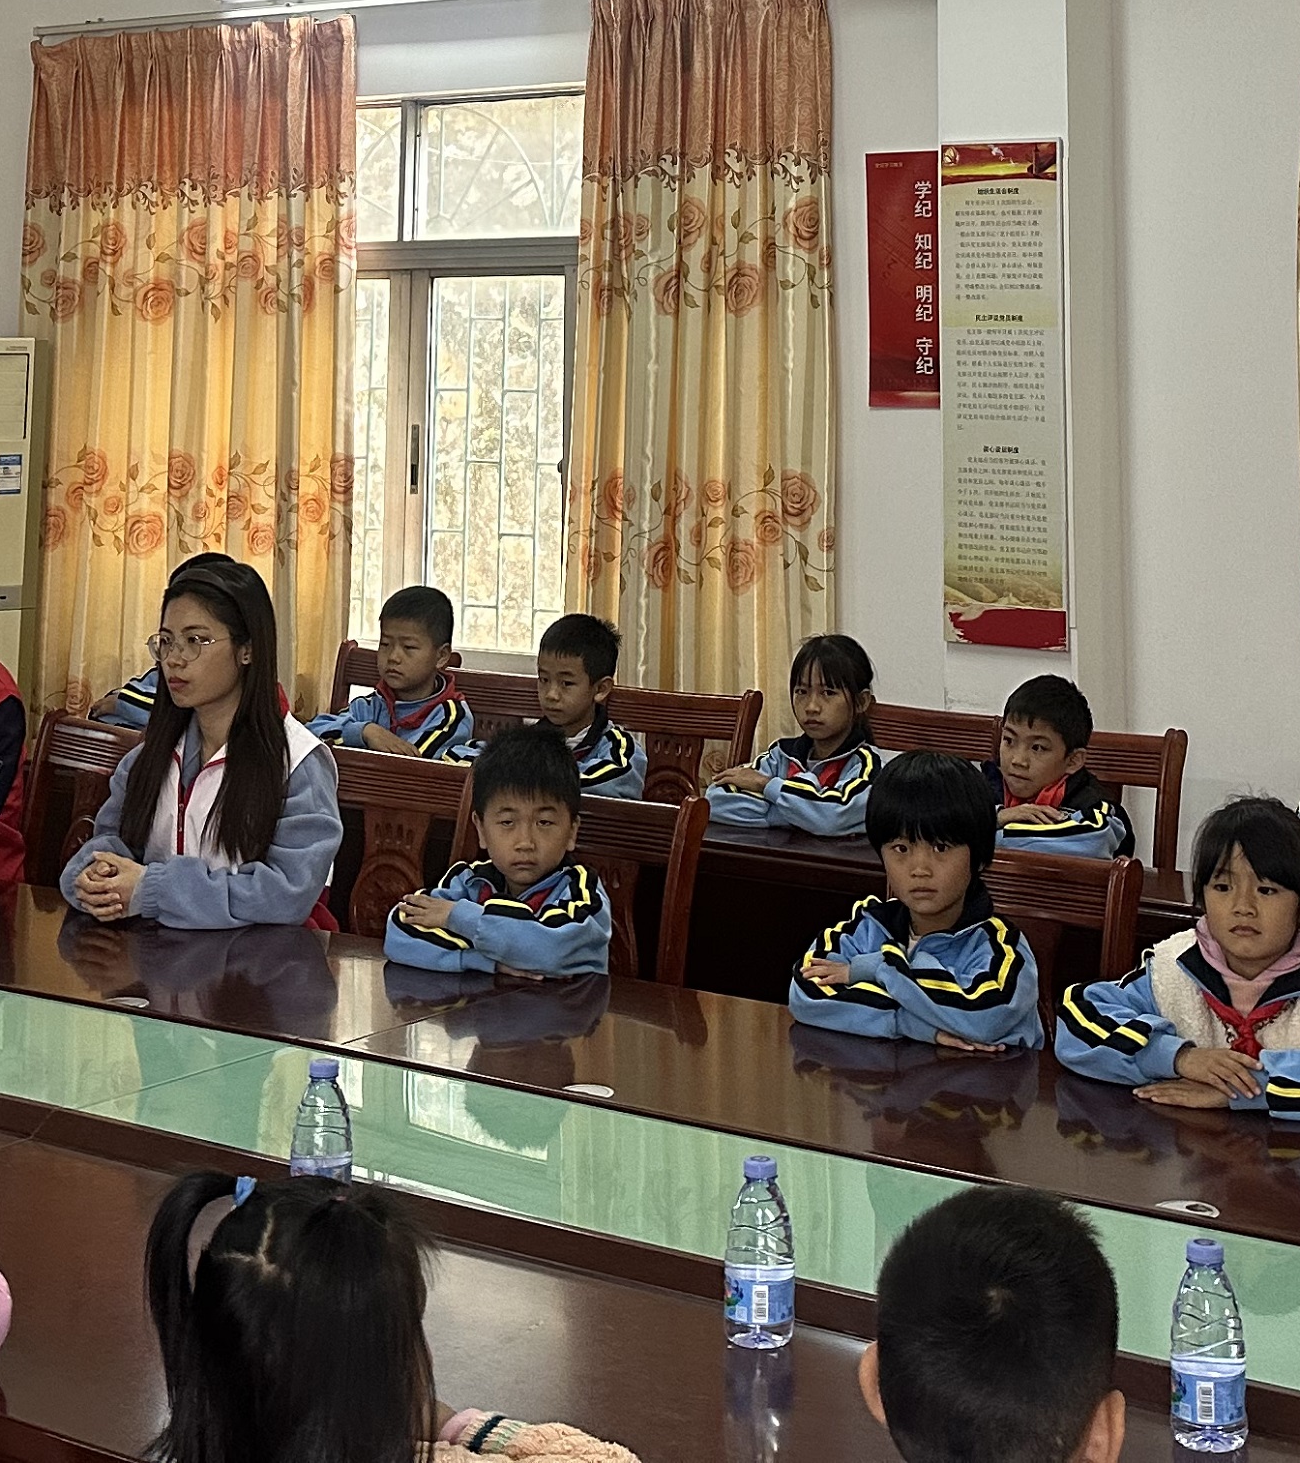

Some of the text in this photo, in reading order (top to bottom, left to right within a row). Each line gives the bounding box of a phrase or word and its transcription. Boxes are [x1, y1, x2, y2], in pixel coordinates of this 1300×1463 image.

[914, 180, 934, 375] 学纪 知纪 明纪 守纪
